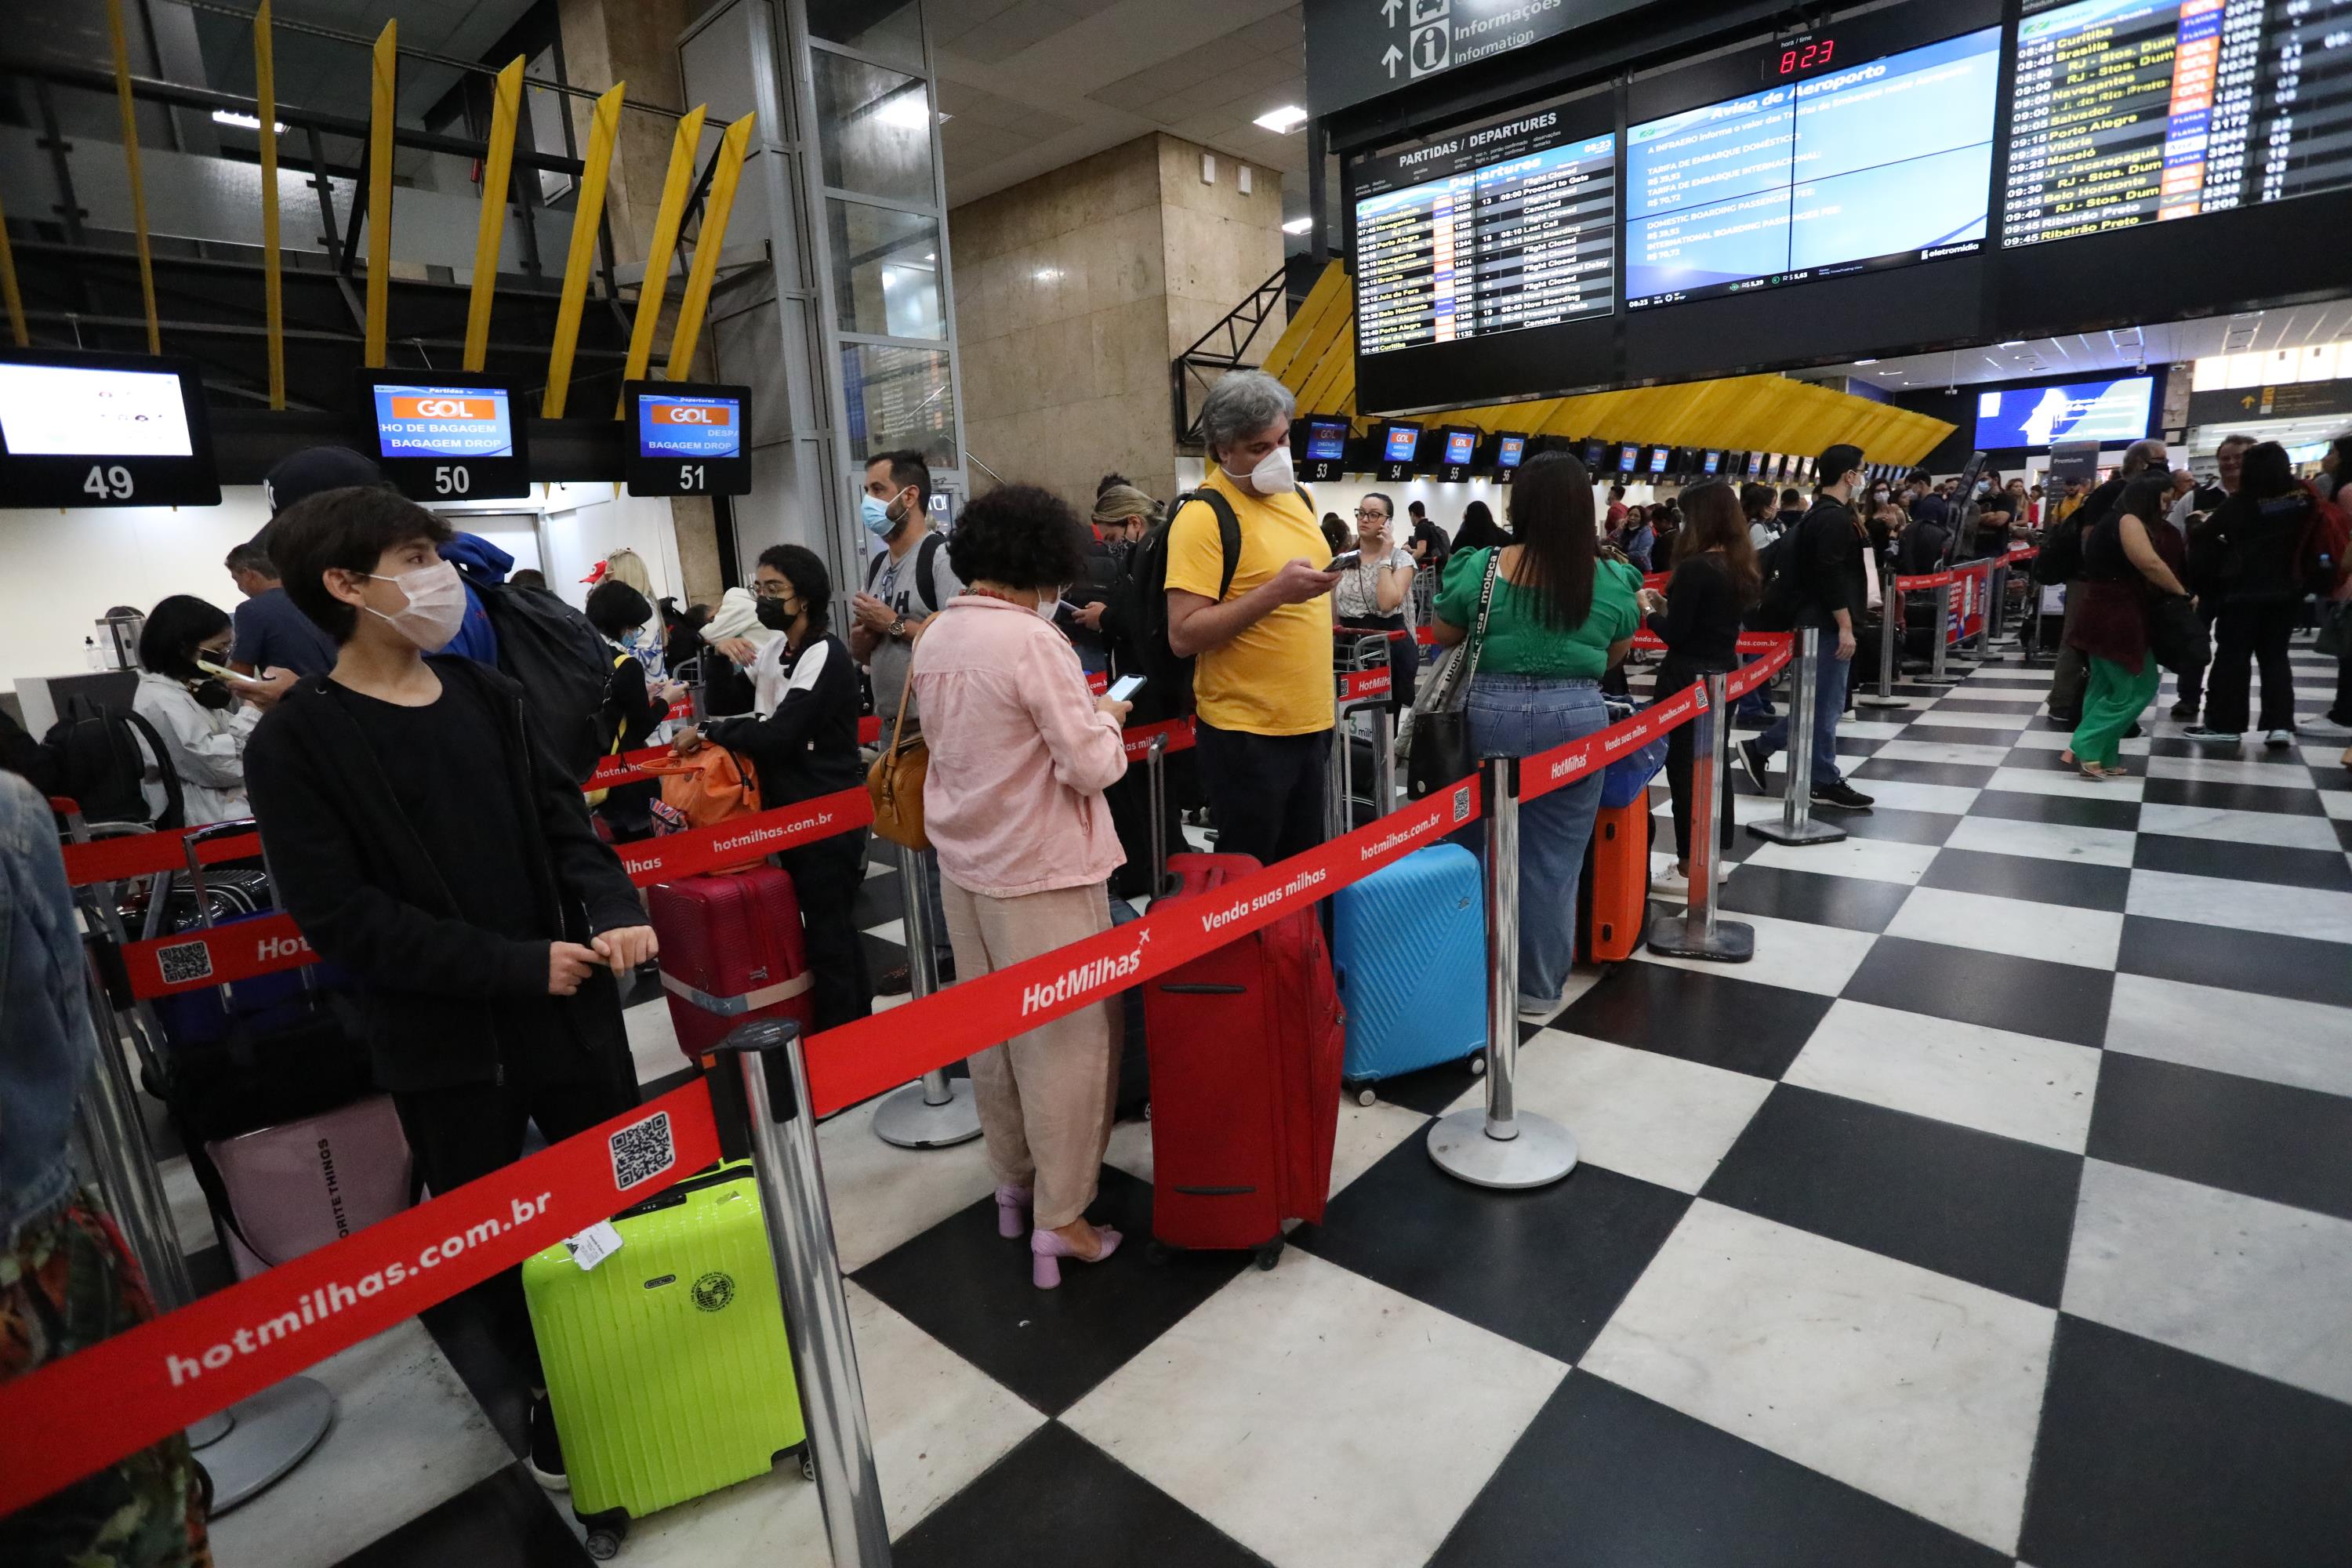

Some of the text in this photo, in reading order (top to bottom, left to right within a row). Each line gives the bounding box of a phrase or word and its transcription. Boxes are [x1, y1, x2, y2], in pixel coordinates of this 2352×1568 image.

[1455, 0, 1562, 41] Informações
[1455, 29, 1534, 64] Information
[2018, 27, 2113, 59] 08:45 Curitiba
[2068, 58, 2087, 71] RJ
[2100, 49, 2136, 64] Stos.
[2141, 37, 2176, 53] Dum
[2016, 50, 2174, 96] 09:00 RJ Stos. Dum
[2017, 54, 2053, 71] 08:45
[1711, 64, 1886, 120] Aviso de Aeroporto
[2014, 94, 2050, 109] 09:00
[2053, 74, 2136, 100] Navegantes
[2013, 107, 2049, 122] 09:00
[2013, 105, 2113, 135] 09:05 Salvador
[1399, 141, 1458, 168] PARTIDAS
[1470, 112, 1557, 147] DEPARTURES
[1656, 135, 1698, 153] INFRAERO
[1700, 126, 1733, 141] informa
[1742, 117, 1763, 131] valor
[1765, 113, 1782, 125] das
[1784, 104, 1817, 120] Tarifas
[2012, 133, 2047, 149] 09:15
[2049, 125, 2087, 140] Porto
[2091, 114, 2138, 132] Alegre
[1648, 160, 1677, 176] TARIFA
[1678, 158, 1690, 168] DE
[1692, 144, 1741, 165] EMBARQUE
[2009, 150, 2096, 173] 09:25 Maceió
[2010, 136, 2092, 162] 09:25 Vitória
[1449, 158, 1542, 189] Departures
[1523, 167, 1577, 186] Flight Closed
[2007, 161, 2162, 199] 09:30 RJ Stos. Dum
[2008, 147, 2159, 186] 09:25 Jacarepaguá
[1523, 182, 1557, 196] Proceed
[1568, 174, 1589, 185] Gate
[1647, 176, 1658, 186] R$
[1647, 181, 1676, 196] TARIFA
[1678, 179, 1690, 190] DE
[1691, 167, 1740, 187] EMBARQUE
[2006, 176, 2147, 210] 09:35 Belo Horizonte
[1523, 200, 1562, 214] Canceled
[1647, 194, 1681, 208] R$ 70,72
[1647, 212, 1690, 230] DOMESTIC
[1690, 203, 1737, 220] BOARDING
[1738, 191, 1791, 210] PASSENGER
[2005, 186, 2159, 223] 09:40 RJ Stos. Dum
[1377, 218, 1417, 232] Navegantes
[1523, 223, 1541, 234] Last
[1542, 220, 1559, 230] Call
[1646, 209, 1820, 251] INTERNATIONAL BOARDING PASSENGER
[2004, 233, 2039, 247] 09:45
[2041, 223, 2097, 241] Ribeirão
[2101, 216, 2139, 230] Preto
[2005, 202, 2140, 234] 09:45 Ribeirão Preto
[1523, 225, 1581, 243] Now Boarding
[1647, 231, 1657, 241] R$
[1523, 256, 1577, 273] Flight Closed
[1646, 248, 1680, 262] R$ 70,72
[1403, 287, 1420, 296] Fora
[1523, 300, 1542, 310] Now
[1543, 294, 1581, 307] Boarding
[1629, 299, 1648, 308] 08:23
[1379, 343, 1406, 351] Curitiba
[417, 400, 474, 418] GOL
[670, 408, 713, 423] GOL
[406, 424, 426, 433] DE
[429, 424, 497, 434] BAGAGEM
[1396, 434, 1410, 443] GOL
[1455, 437, 1467, 447] GOL
[391, 439, 502, 448] BAGAGEM DROP
[648, 441, 702, 449] BAGAGEM
[83, 465, 134, 499] 49
[435, 466, 470, 494] 50
[680, 465, 704, 490] 51
[1316, 463, 1328, 479] 53
[1391, 464, 1402, 479] 54
[1450, 466, 1460, 480] 55
[1480, 555, 1497, 604] moleca
[1604, 736, 1621, 752] Venda
[1621, 734, 1632, 747] suas
[1632, 724, 1647, 739] milhas
[713, 812, 833, 853] hotmilhas.com.br
[1201, 901, 1249, 932] Venda
[1252, 886, 1283, 912] suas
[1285, 867, 1327, 897] milhas
[1361, 812, 1441, 861] hotmilhas.com.br
[318, 1138, 339, 1196] THINGS
[165, 1190, 552, 1388] hotmilhas.com.br
